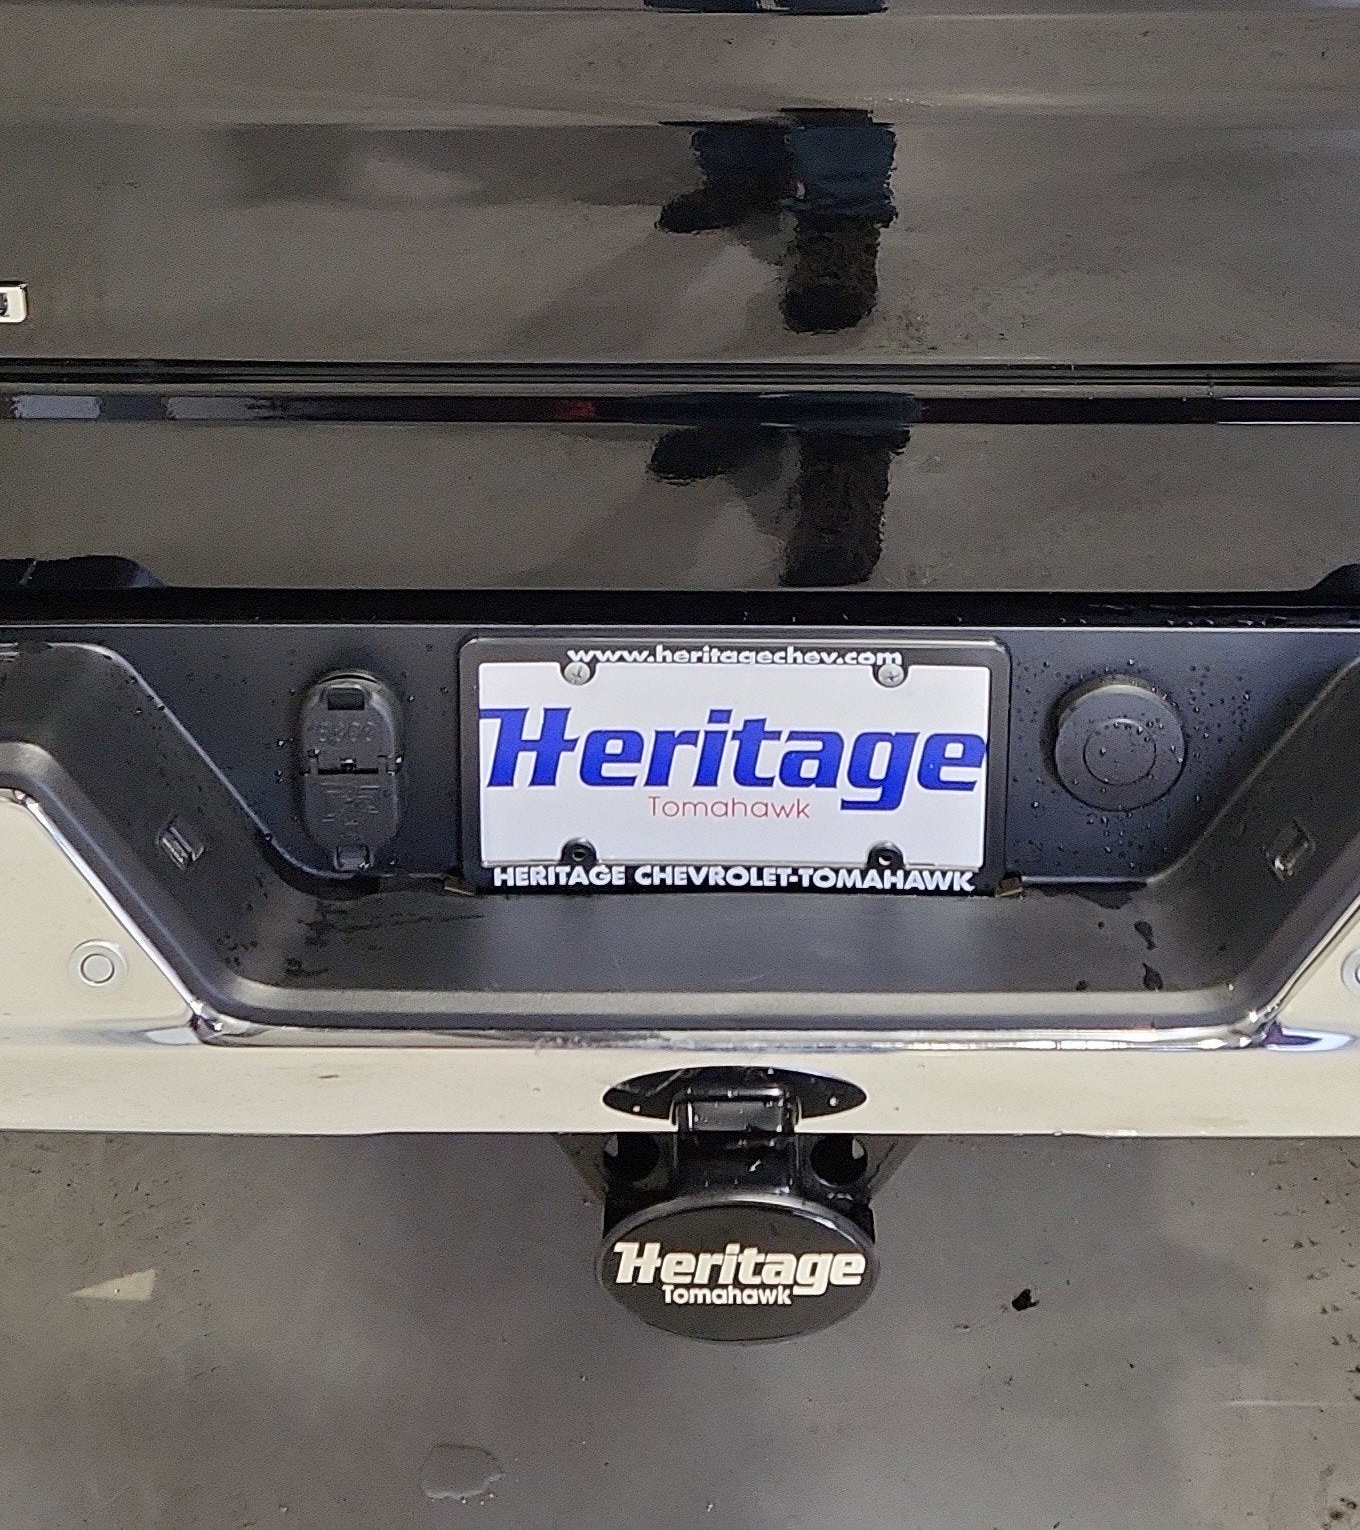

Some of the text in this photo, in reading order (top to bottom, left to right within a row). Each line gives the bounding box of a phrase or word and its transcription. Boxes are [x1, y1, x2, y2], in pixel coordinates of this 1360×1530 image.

[567, 644, 903, 666] www.heritagechev.com
[478, 706, 987, 811] Heritage
[647, 795, 811, 820] Tomahawk
[493, 865, 976, 892] HERITAGE CHEVROLET-TOMAHAWK
[613, 1242, 867, 1296] Heritage
[661, 1283, 792, 1305] Tomahawk
